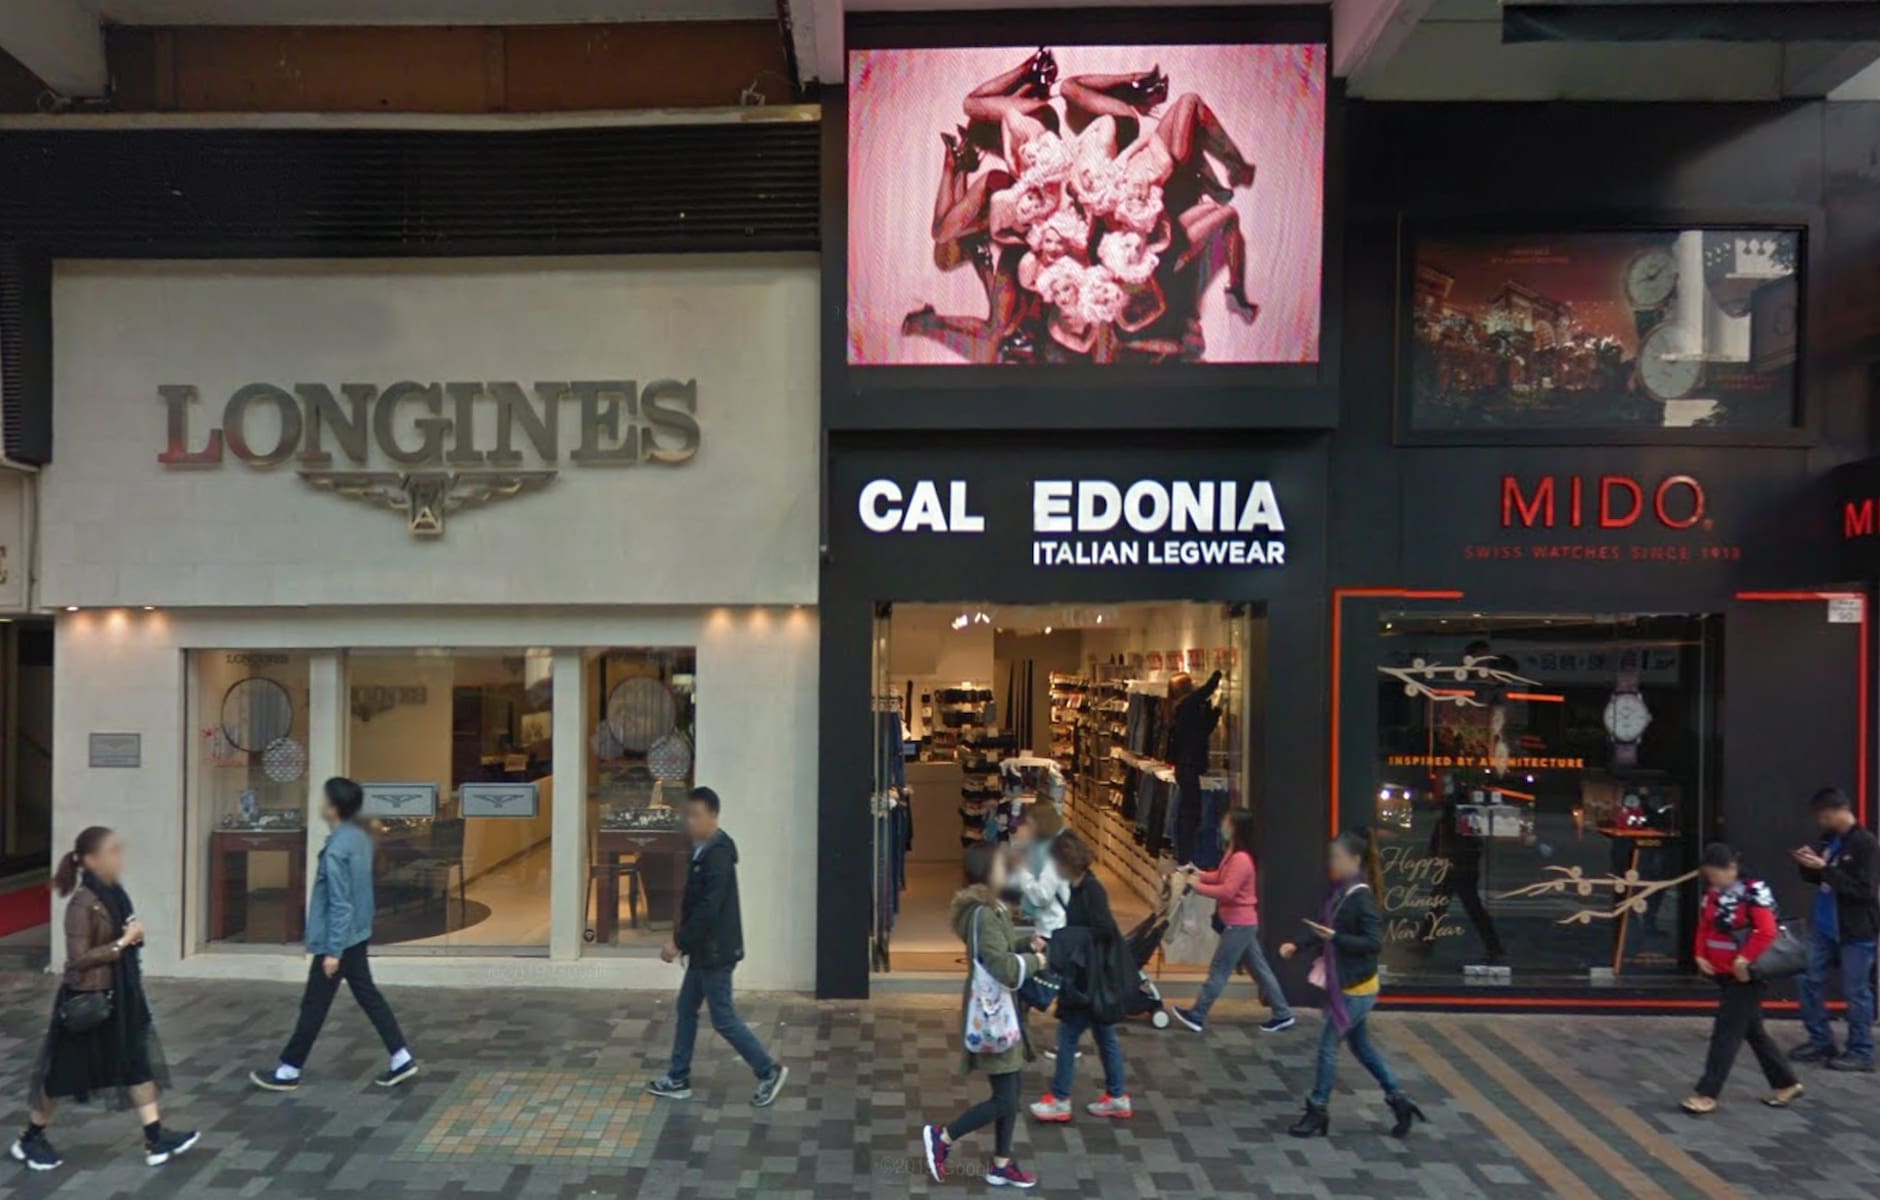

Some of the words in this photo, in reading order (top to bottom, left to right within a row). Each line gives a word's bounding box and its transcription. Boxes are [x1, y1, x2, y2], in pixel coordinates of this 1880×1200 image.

[156, 377, 701, 467] LONGINES
[858, 479, 985, 533] CAL
[1033, 480, 1286, 533] EDONIA
[1033, 541, 1140, 566] ITALIAN
[1147, 541, 1286, 566] LEGWEAR
[1463, 546, 1524, 561] SWISS
[1531, 546, 1621, 561] WATCHES
[1388, 756, 1452, 767] INSPIRED
[1456, 757, 1474, 767] BY
[1380, 846, 1454, 886] Happy
